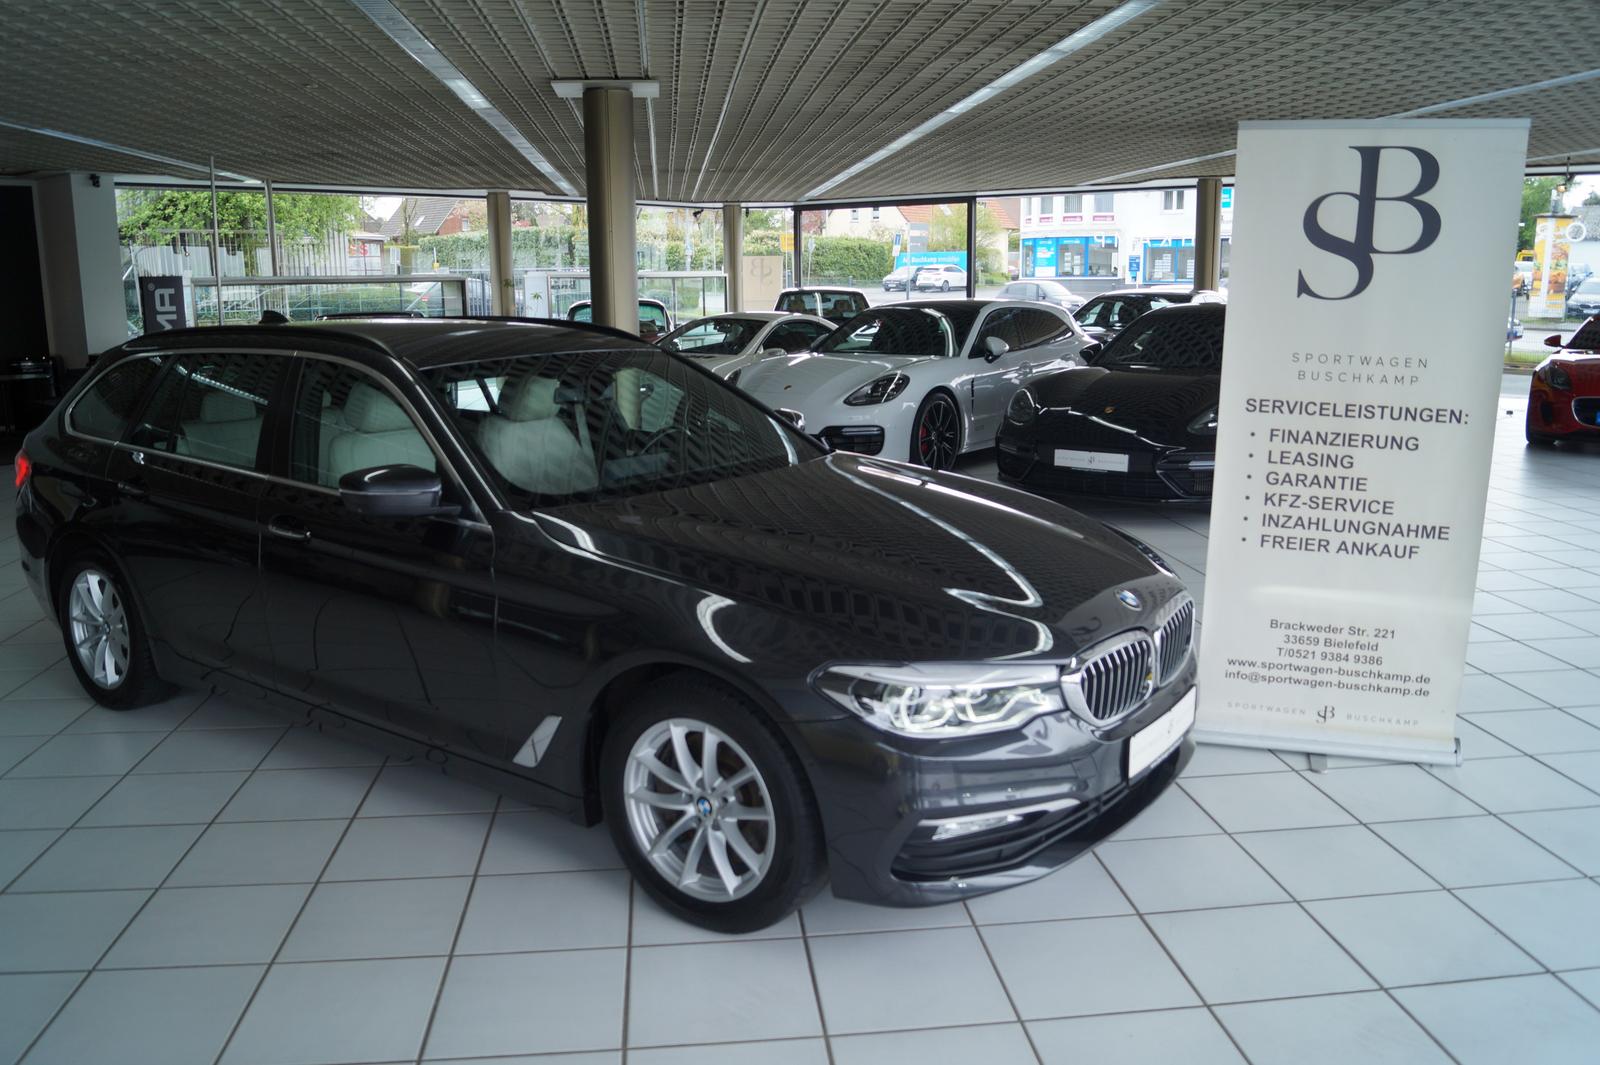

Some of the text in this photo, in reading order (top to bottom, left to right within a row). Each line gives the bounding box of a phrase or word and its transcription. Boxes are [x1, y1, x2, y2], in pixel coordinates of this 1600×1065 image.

[1292, 352, 1427, 368] SPORTWAGEN
[1298, 370, 1418, 385] BUSCHKAMP
[1245, 398, 1469, 424] SERVICELEISTUNGEN:
[1269, 428, 1419, 451] FINANZIERUNG
[1268, 450, 1354, 469] LEASING
[1266, 471, 1368, 492] GARANTIE
[1264, 492, 1394, 515] KFZ-SERVICE
[1262, 513, 1450, 540] INZAHLUNGNAHME
[1260, 534, 1420, 559] FREIER ANKAUF
[1270, 619, 1395, 639] Brackweder Str. 221
[1284, 634, 1378, 651] 33659 Bielefeld
[1277, 647, 1382, 667] T/0521 9384 9386
[1225, 670, 1429, 696] info@sportwagen-buschkamp.de
[1226, 659, 1430, 684] www.sportwagen-buschkamp.de
[1228, 702, 1305, 715] SPORTWAGEN
[1347, 714, 1418, 725] BUSCHKAMP
